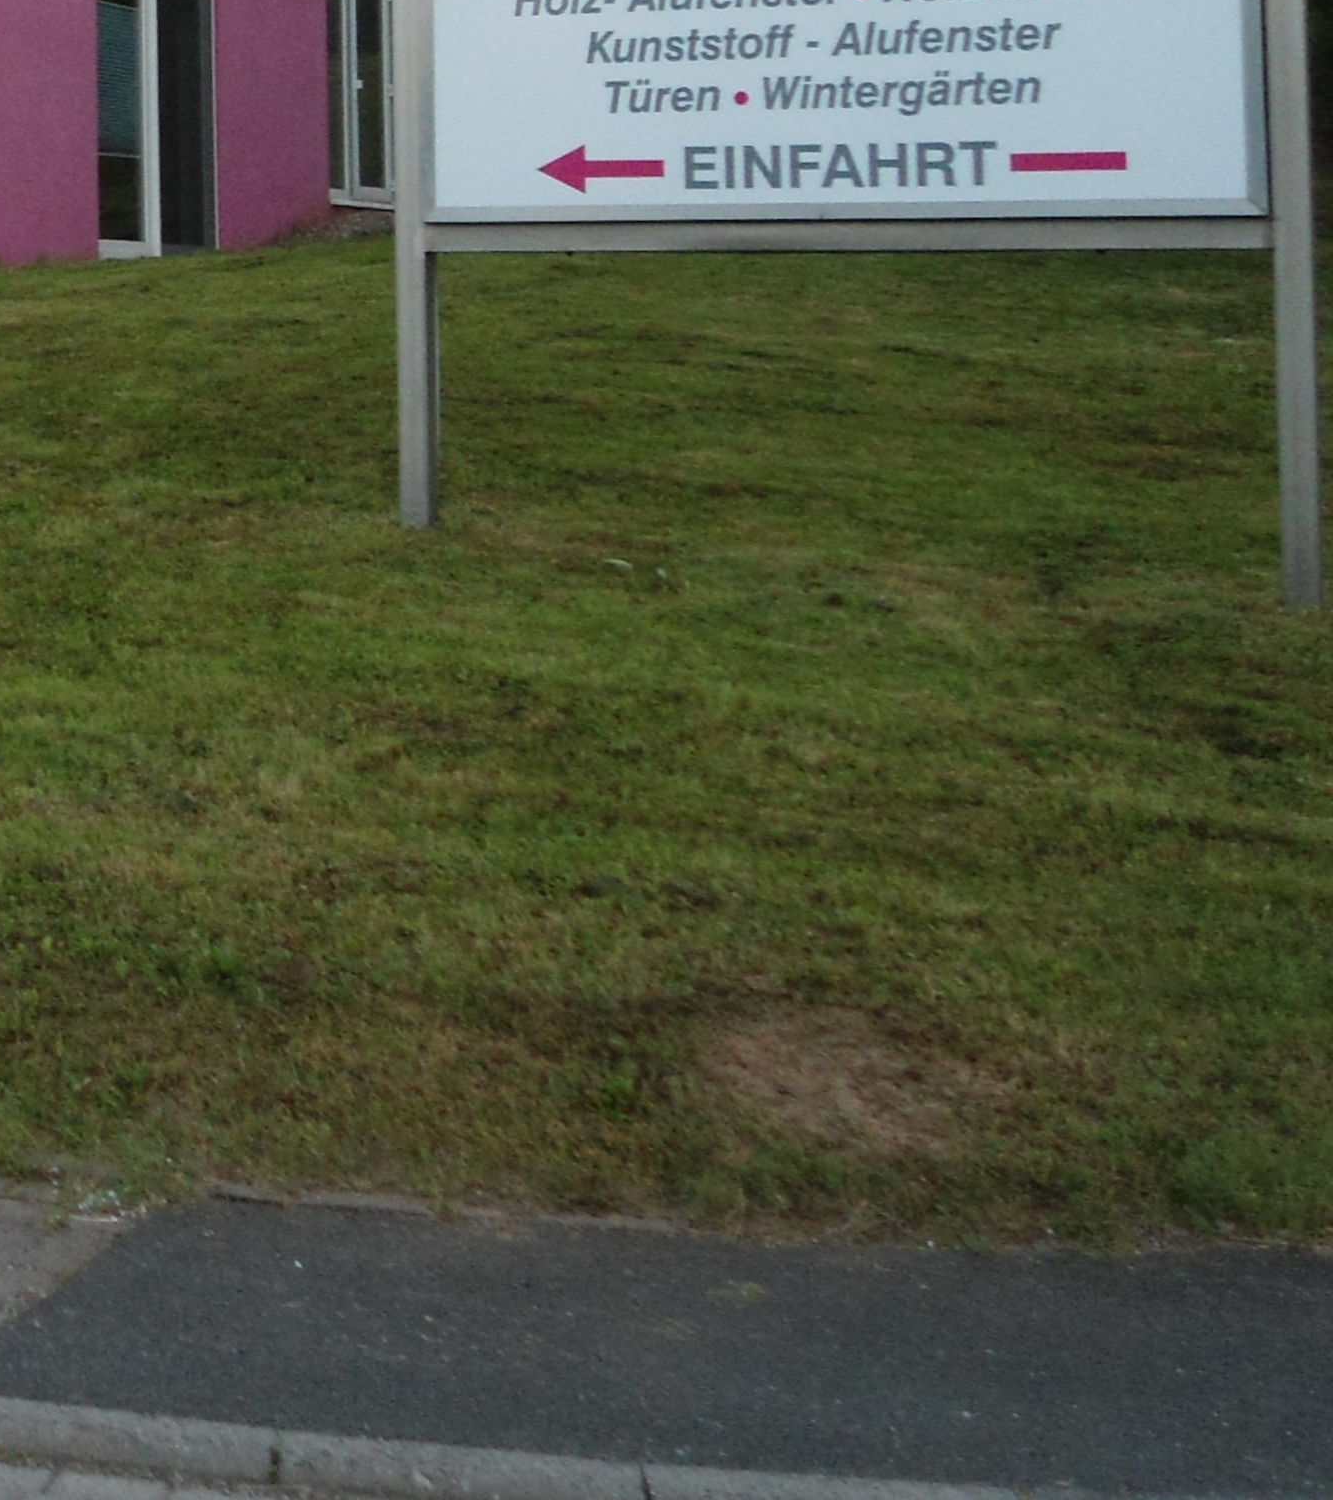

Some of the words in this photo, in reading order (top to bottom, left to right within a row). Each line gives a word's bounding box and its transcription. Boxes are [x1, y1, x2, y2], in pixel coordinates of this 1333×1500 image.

[586, 24, 795, 64] Kunststoff
[831, 18, 1062, 56] Alufenster
[605, 79, 721, 114] Türen
[762, 70, 1042, 116] Wintergärten
[684, 141, 998, 189] EINFAHRT
